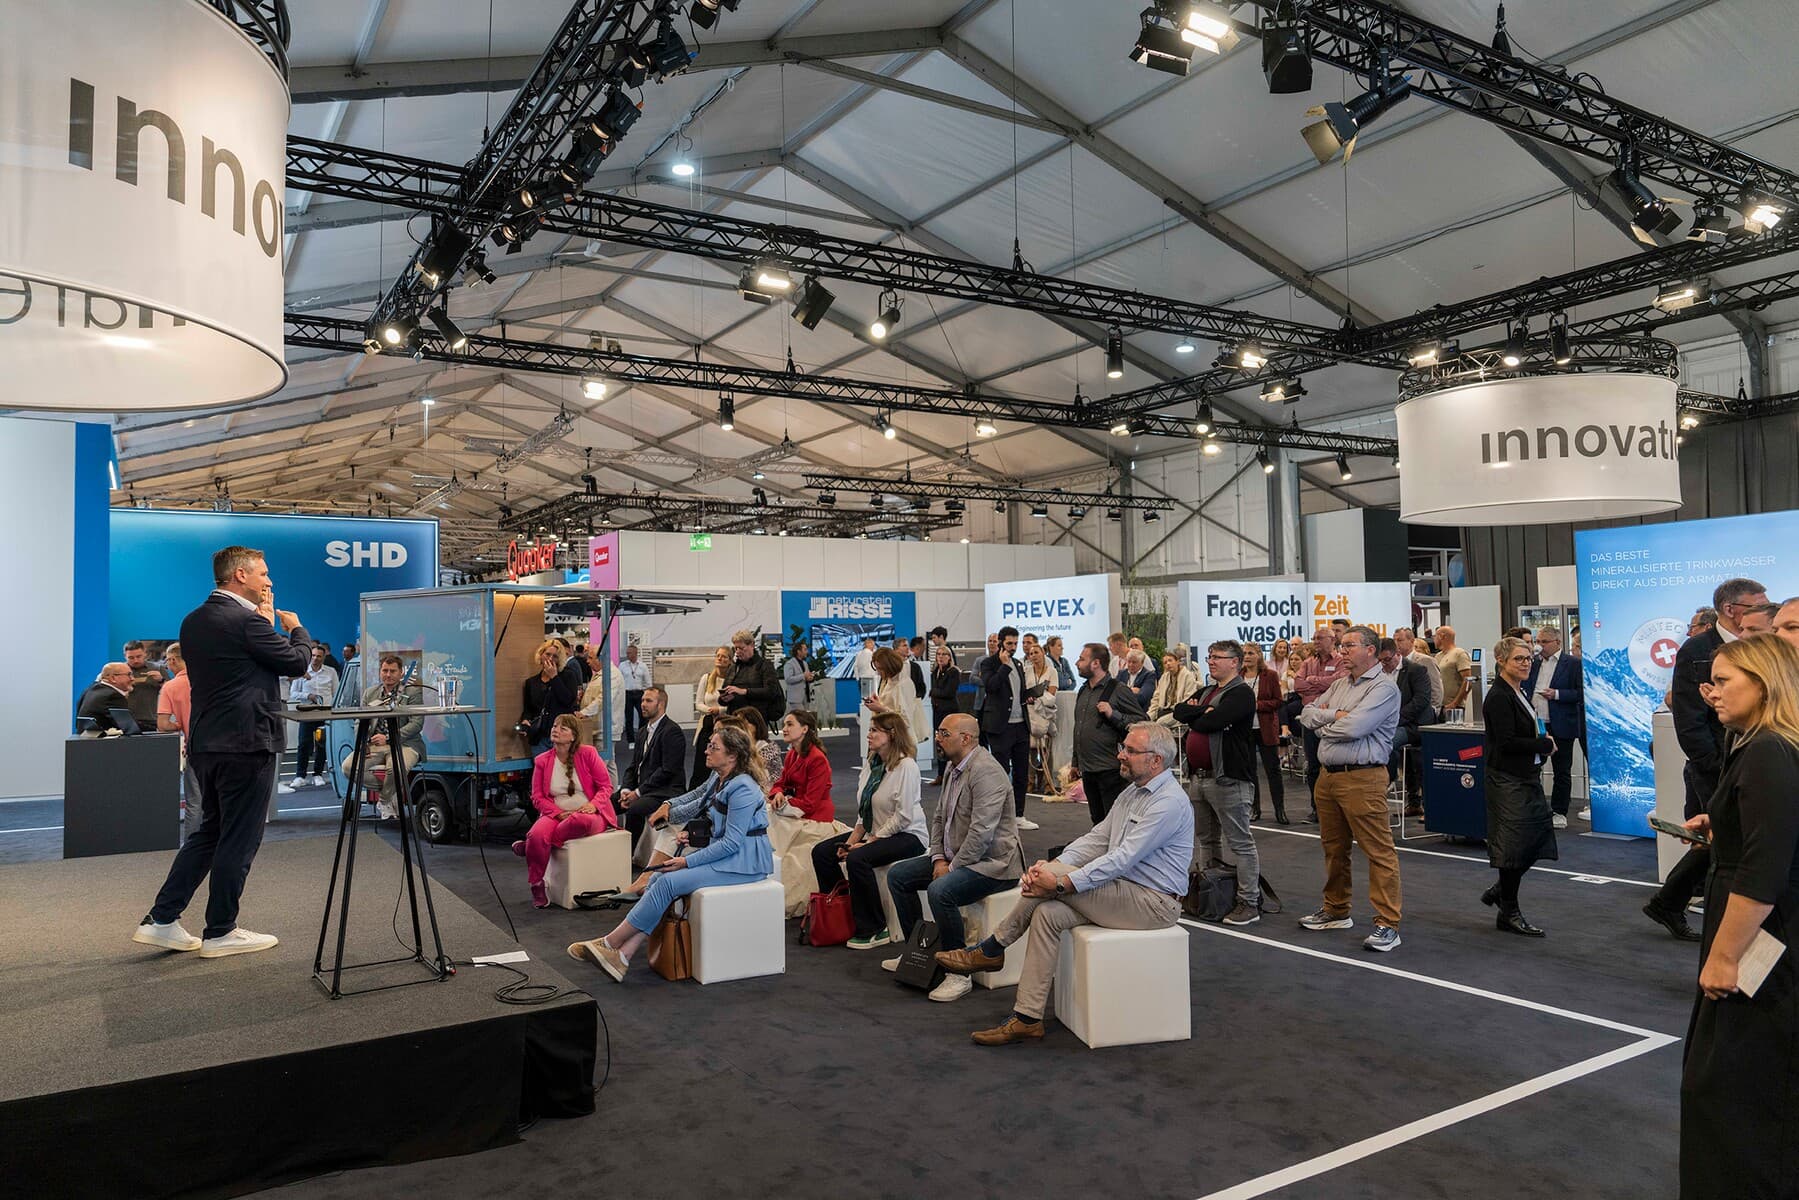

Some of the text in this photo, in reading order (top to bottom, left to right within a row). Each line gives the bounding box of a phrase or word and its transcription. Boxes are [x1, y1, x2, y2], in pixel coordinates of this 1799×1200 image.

[1481, 420, 1678, 464] innovati
[324, 540, 408, 568] SHD
[1590, 550, 1649, 563] DAS BESTE
[1591, 555, 1777, 577] MINERALISIERTE TRINKWASSER
[1592, 579, 1630, 591] DIREKT
[1634, 577, 1657, 588] AUS
[1660, 575, 1685, 586] DER
[828, 595, 893, 605] naturstein
[1003, 598, 1085, 619] PREVEX
[1207, 595, 1302, 621] Frag doch
[1314, 595, 1349, 616] Zeit
[1056, 623, 1071, 631] future
[1237, 626, 1276, 642] was
[1279, 620, 1302, 642] du
